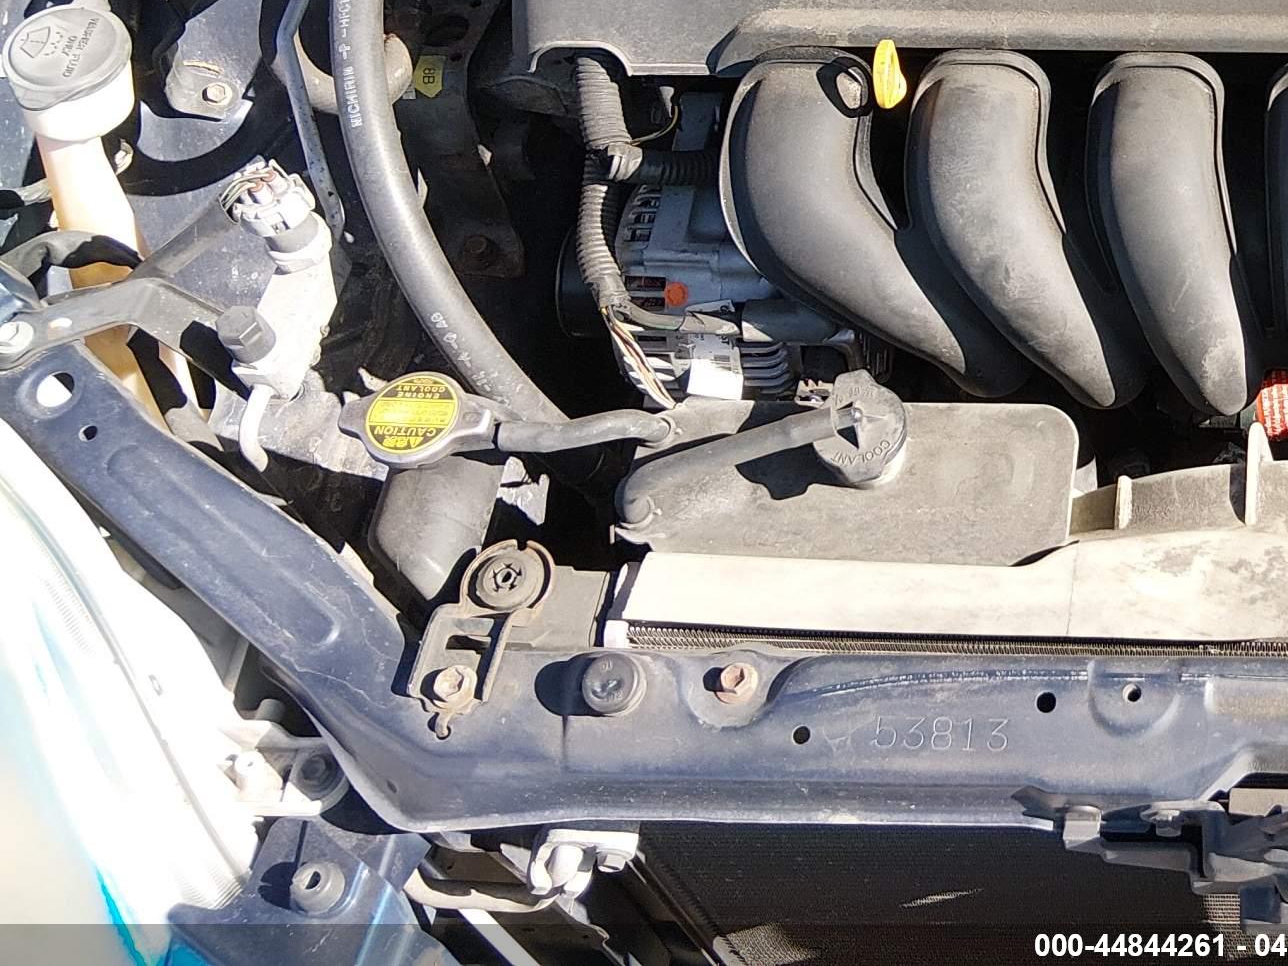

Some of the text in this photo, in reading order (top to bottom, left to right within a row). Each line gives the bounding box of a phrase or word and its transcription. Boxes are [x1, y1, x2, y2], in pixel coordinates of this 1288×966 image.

[61, 35, 78, 56] ONLY
[62, 53, 80, 78] FLUID
[422, 67, 435, 84] 8B
[343, 66, 362, 128] NICHIRIN
[396, 384, 446, 393] COOLANT
[397, 391, 440, 400] ENGINE
[373, 425, 437, 437] CAUTION
[831, 439, 891, 466] COOLANT
[870, 715, 1009, 752] 53813
